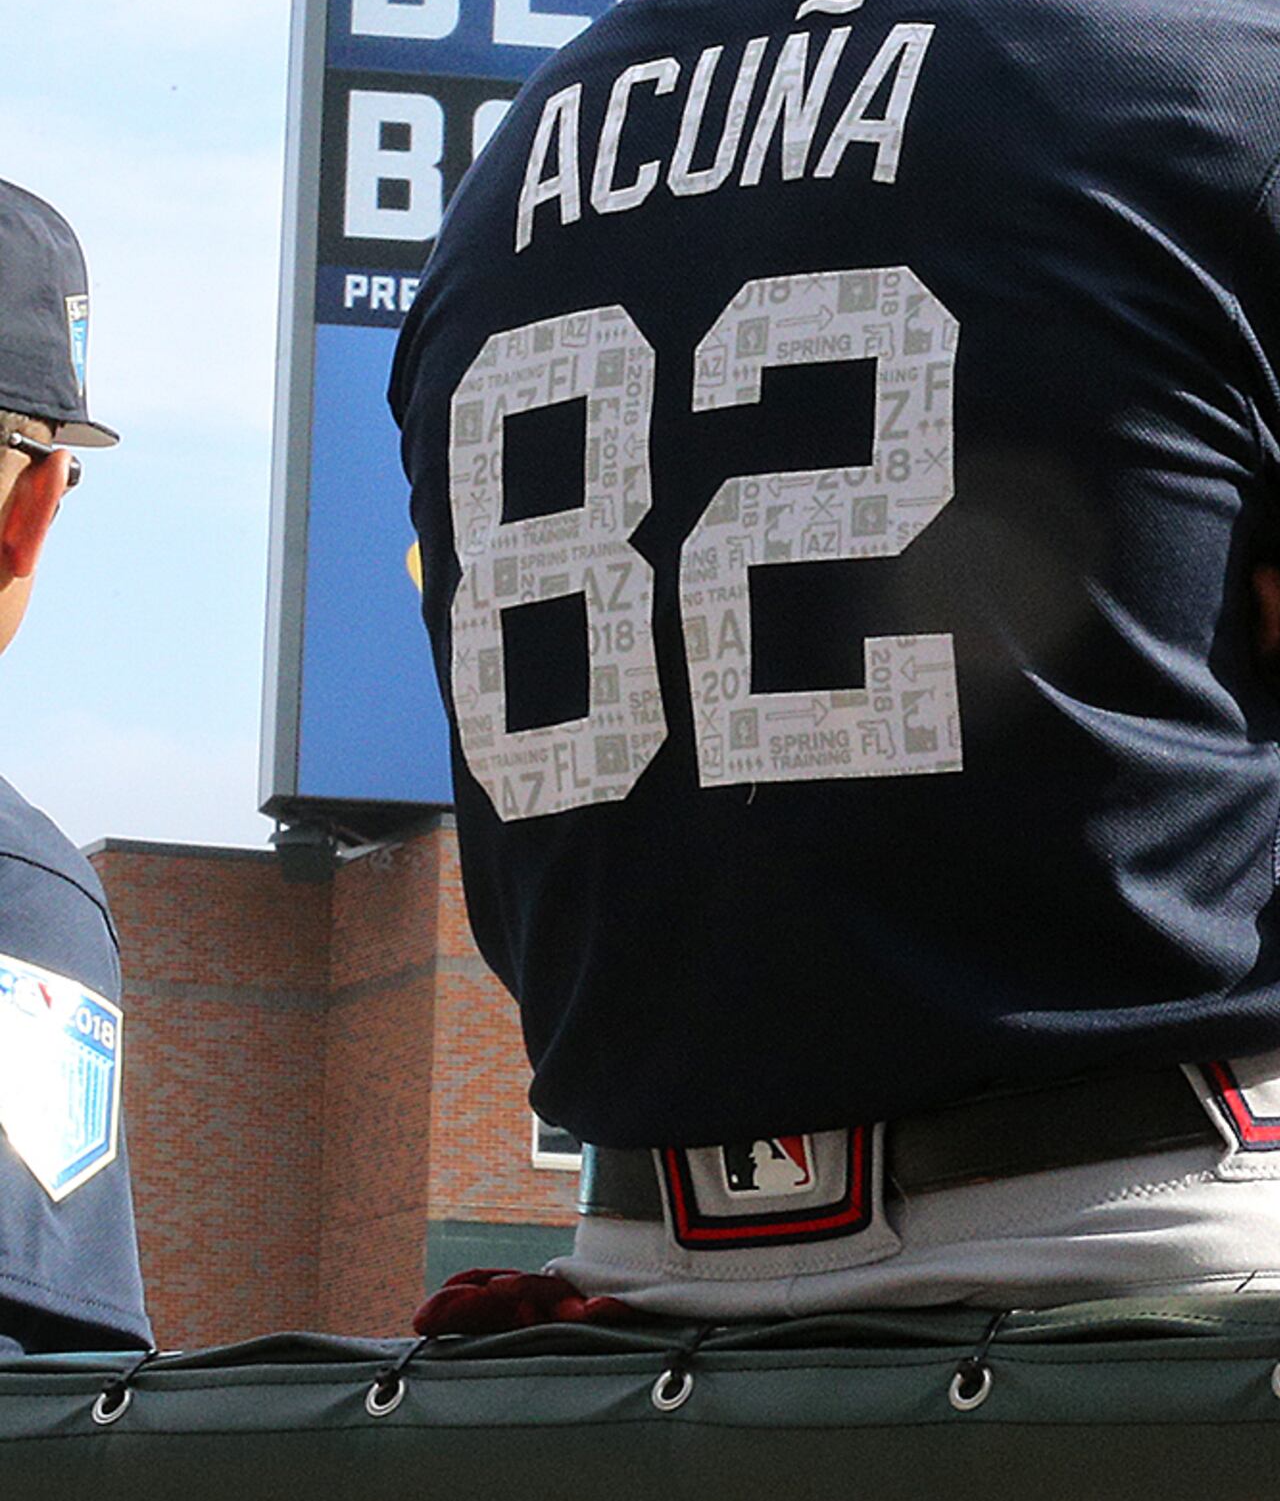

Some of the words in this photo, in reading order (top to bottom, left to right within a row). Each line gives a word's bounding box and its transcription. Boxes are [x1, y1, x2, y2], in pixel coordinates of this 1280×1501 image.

[776, 334, 851, 361] SPRING
[448, 265, 963, 822] 82
[871, 649, 893, 713] 2018
[769, 729, 850, 754] SPRING
[770, 751, 851, 772] TRAINING
